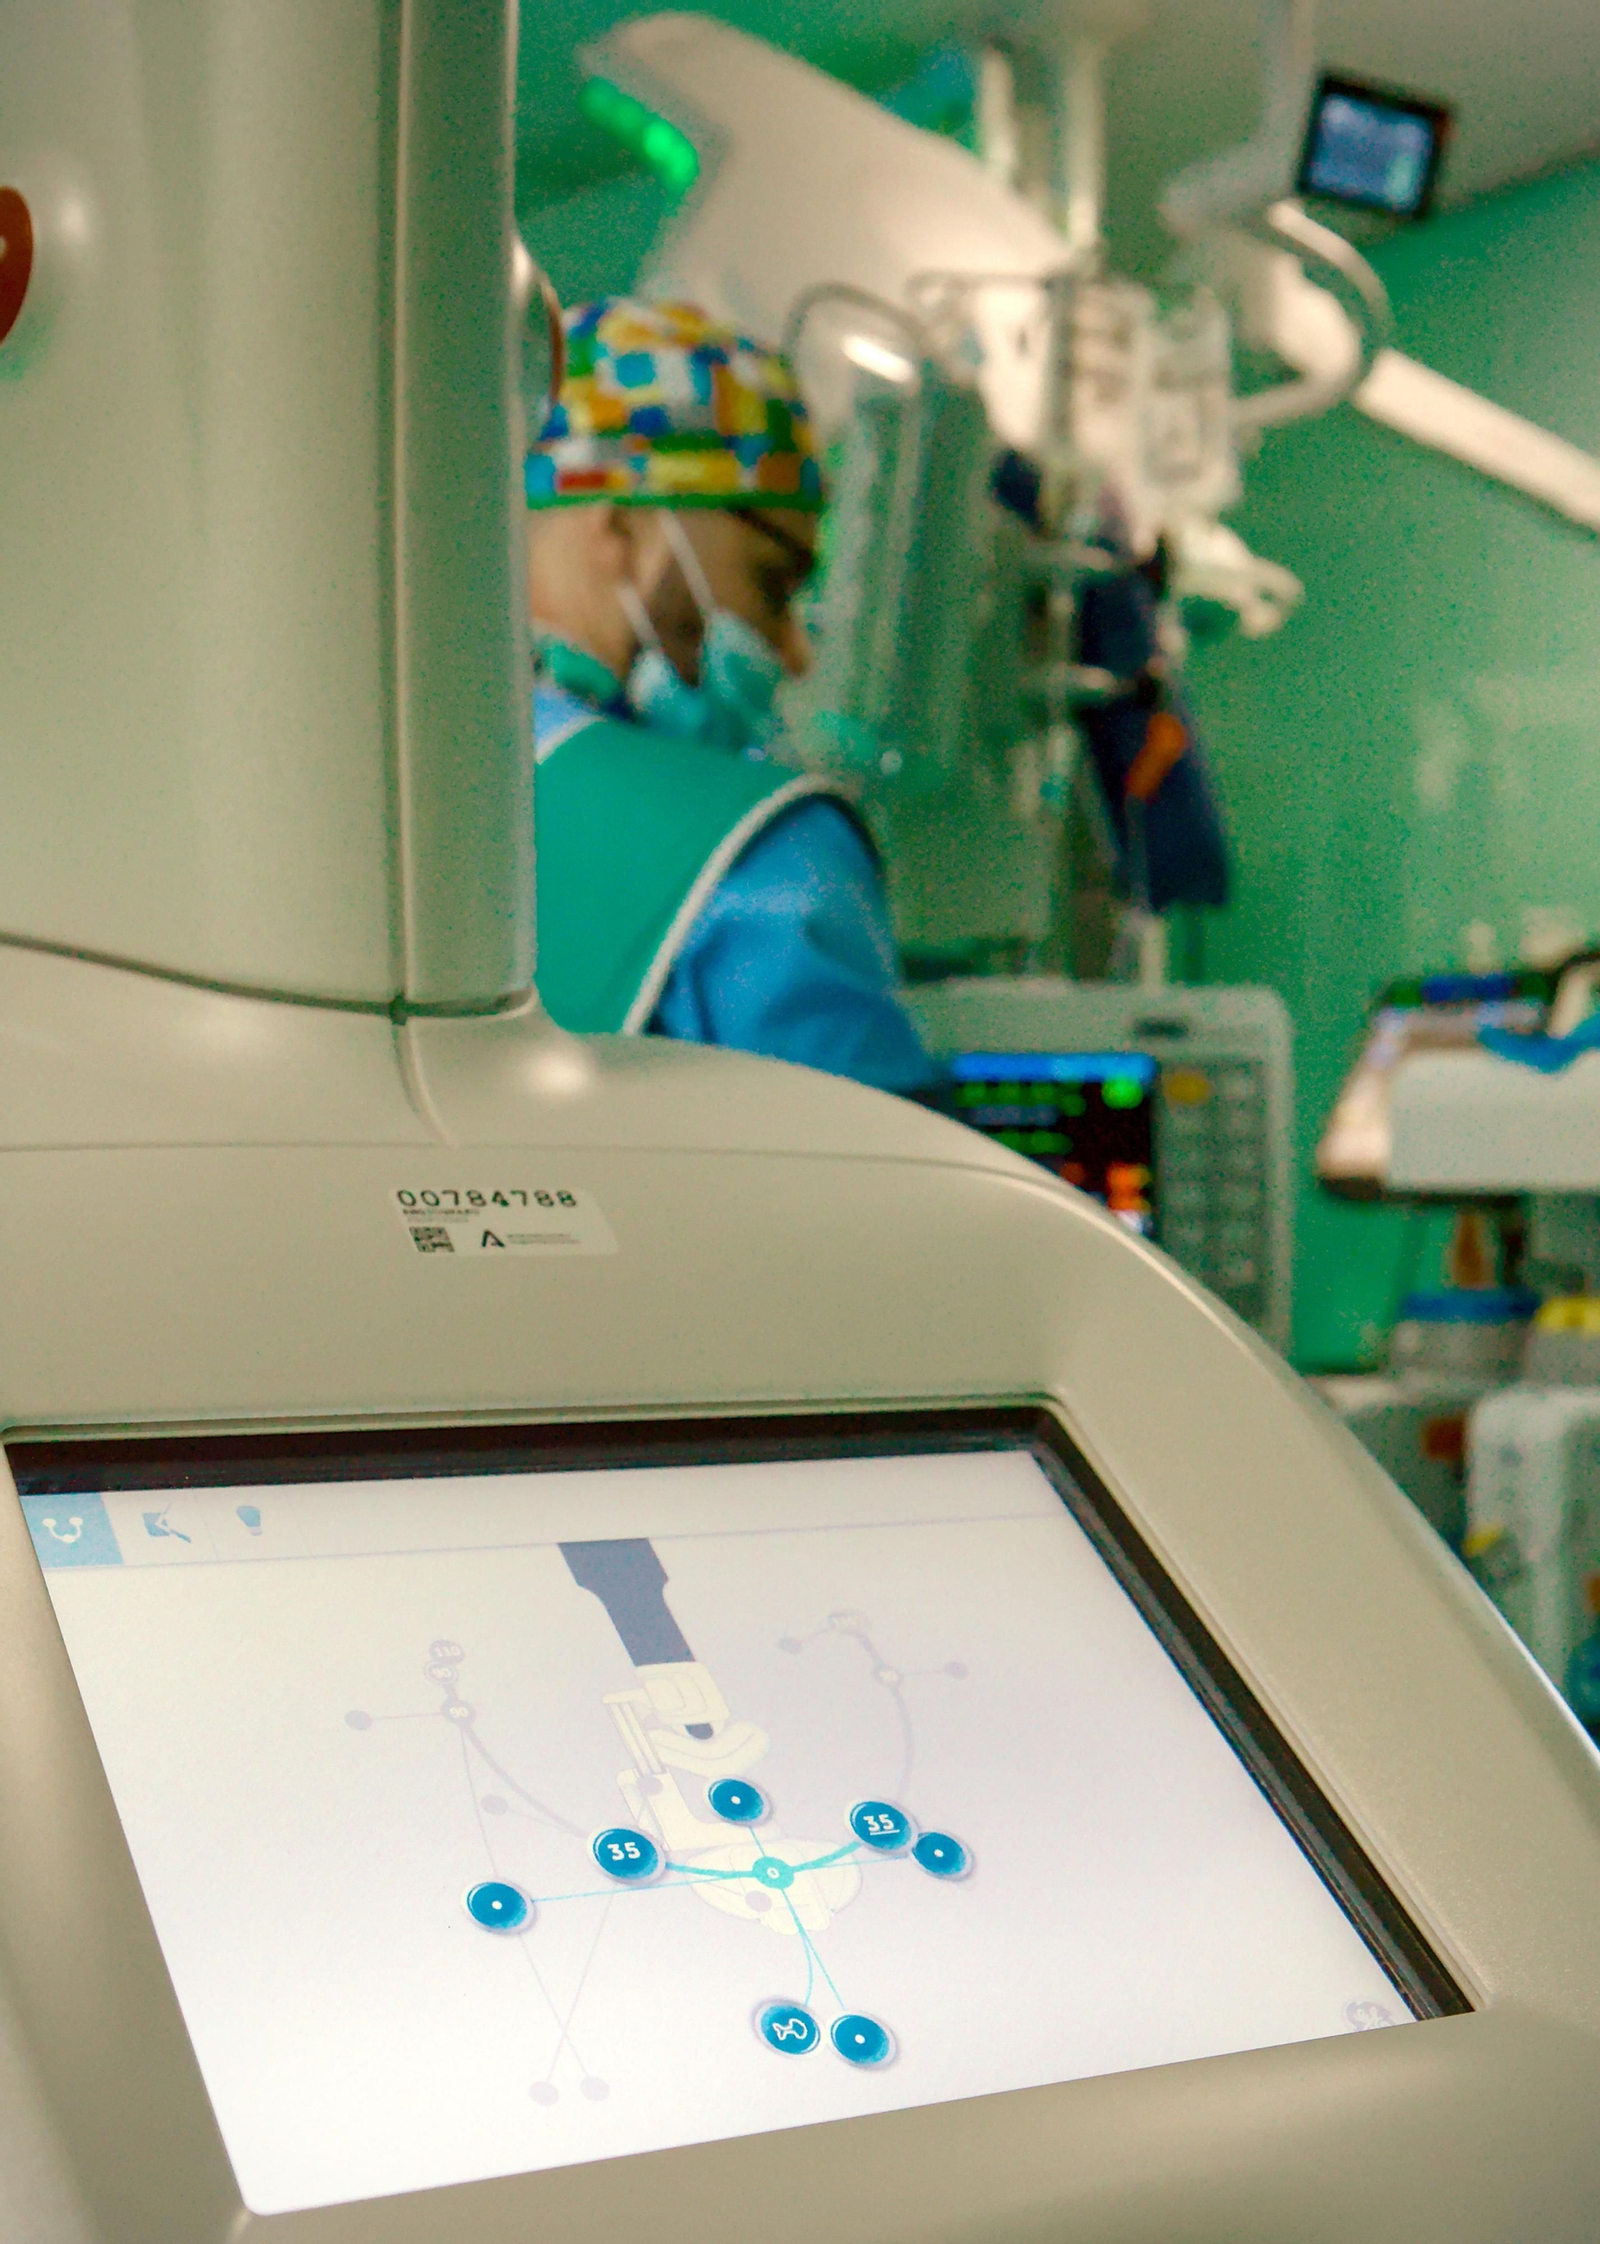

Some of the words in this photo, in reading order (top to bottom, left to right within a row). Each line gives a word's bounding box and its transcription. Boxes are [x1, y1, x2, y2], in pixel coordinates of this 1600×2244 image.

[397, 1189, 577, 1207] 00784788
[863, 1813, 895, 1832] 35
[606, 1842, 641, 1861] 35
